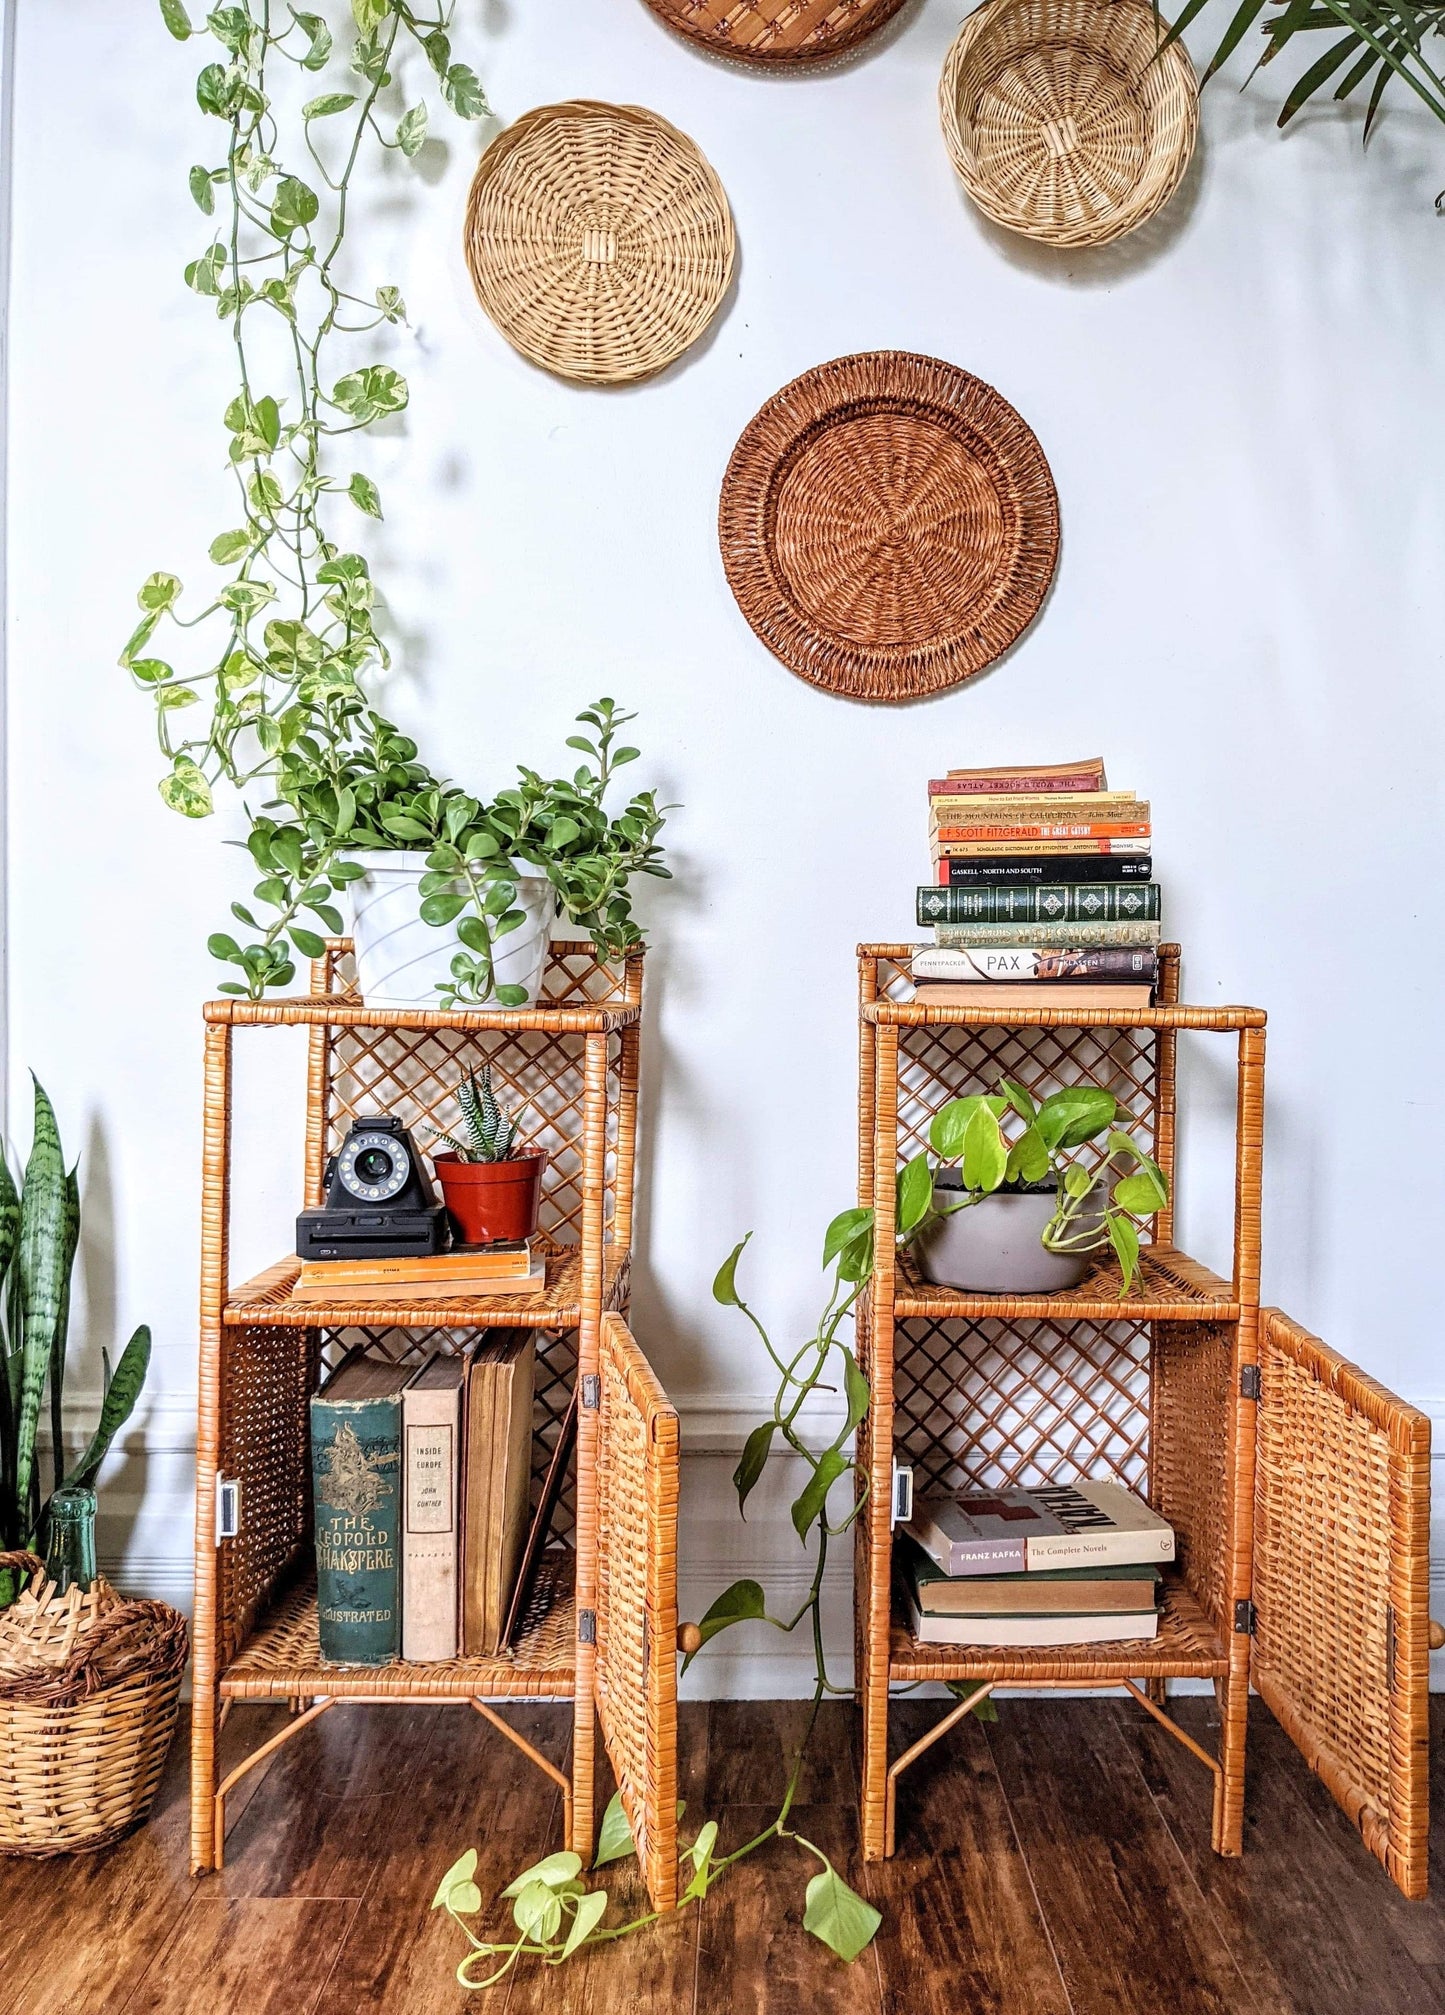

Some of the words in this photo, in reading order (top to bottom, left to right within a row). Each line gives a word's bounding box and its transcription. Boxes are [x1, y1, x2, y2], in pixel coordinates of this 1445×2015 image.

[1029, 811, 1078, 819] CALIFORNIA
[956, 828, 983, 837] SCOTT
[987, 827, 1038, 837] FITZGERALD
[1041, 827, 1050, 836] THE
[1052, 826, 1069, 836] GREAT
[920, 959, 966, 967] PENNYPACKER
[987, 956, 1021, 971] PAX
[1062, 959, 1099, 967] KLASSEN
[416, 1447, 442, 1455] INSIDE
[416, 1460, 442, 1469] EUROPE
[420, 1487, 437, 1495] JOHN
[330, 1515, 375, 1531] THE
[318, 1526, 388, 1548] LEOPOLD
[1032, 1548, 1045, 1556] The
[1047, 1546, 1081, 1556] Complete
[1083, 1544, 1108, 1553] Novels
[316, 1544, 394, 1575] SHAKSPERE
[960, 1552, 990, 1561] FRANZ
[992, 1550, 1021, 1559] KAFKA
